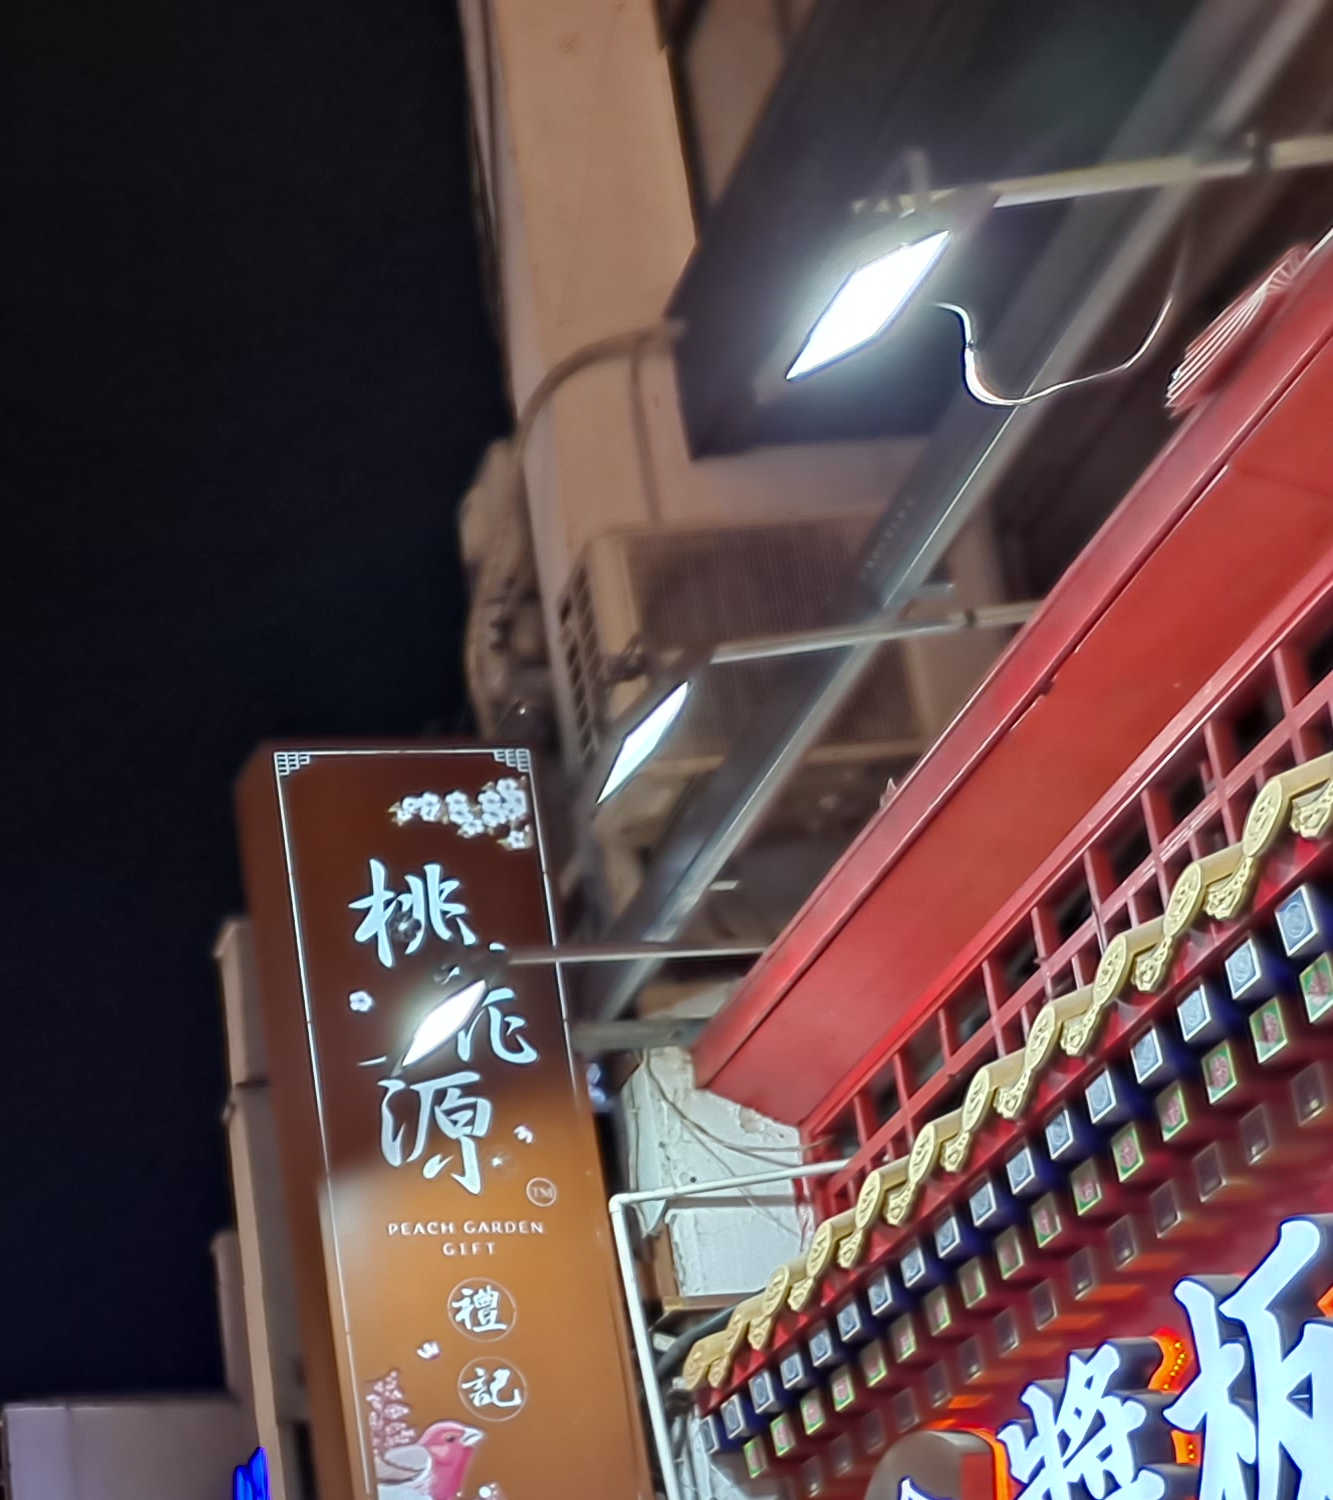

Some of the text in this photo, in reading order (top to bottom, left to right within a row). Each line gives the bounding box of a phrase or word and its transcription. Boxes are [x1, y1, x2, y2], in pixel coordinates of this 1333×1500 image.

[388, 1220, 544, 1236] PEACH GARDEN
[443, 1242, 496, 1256] GIFT
